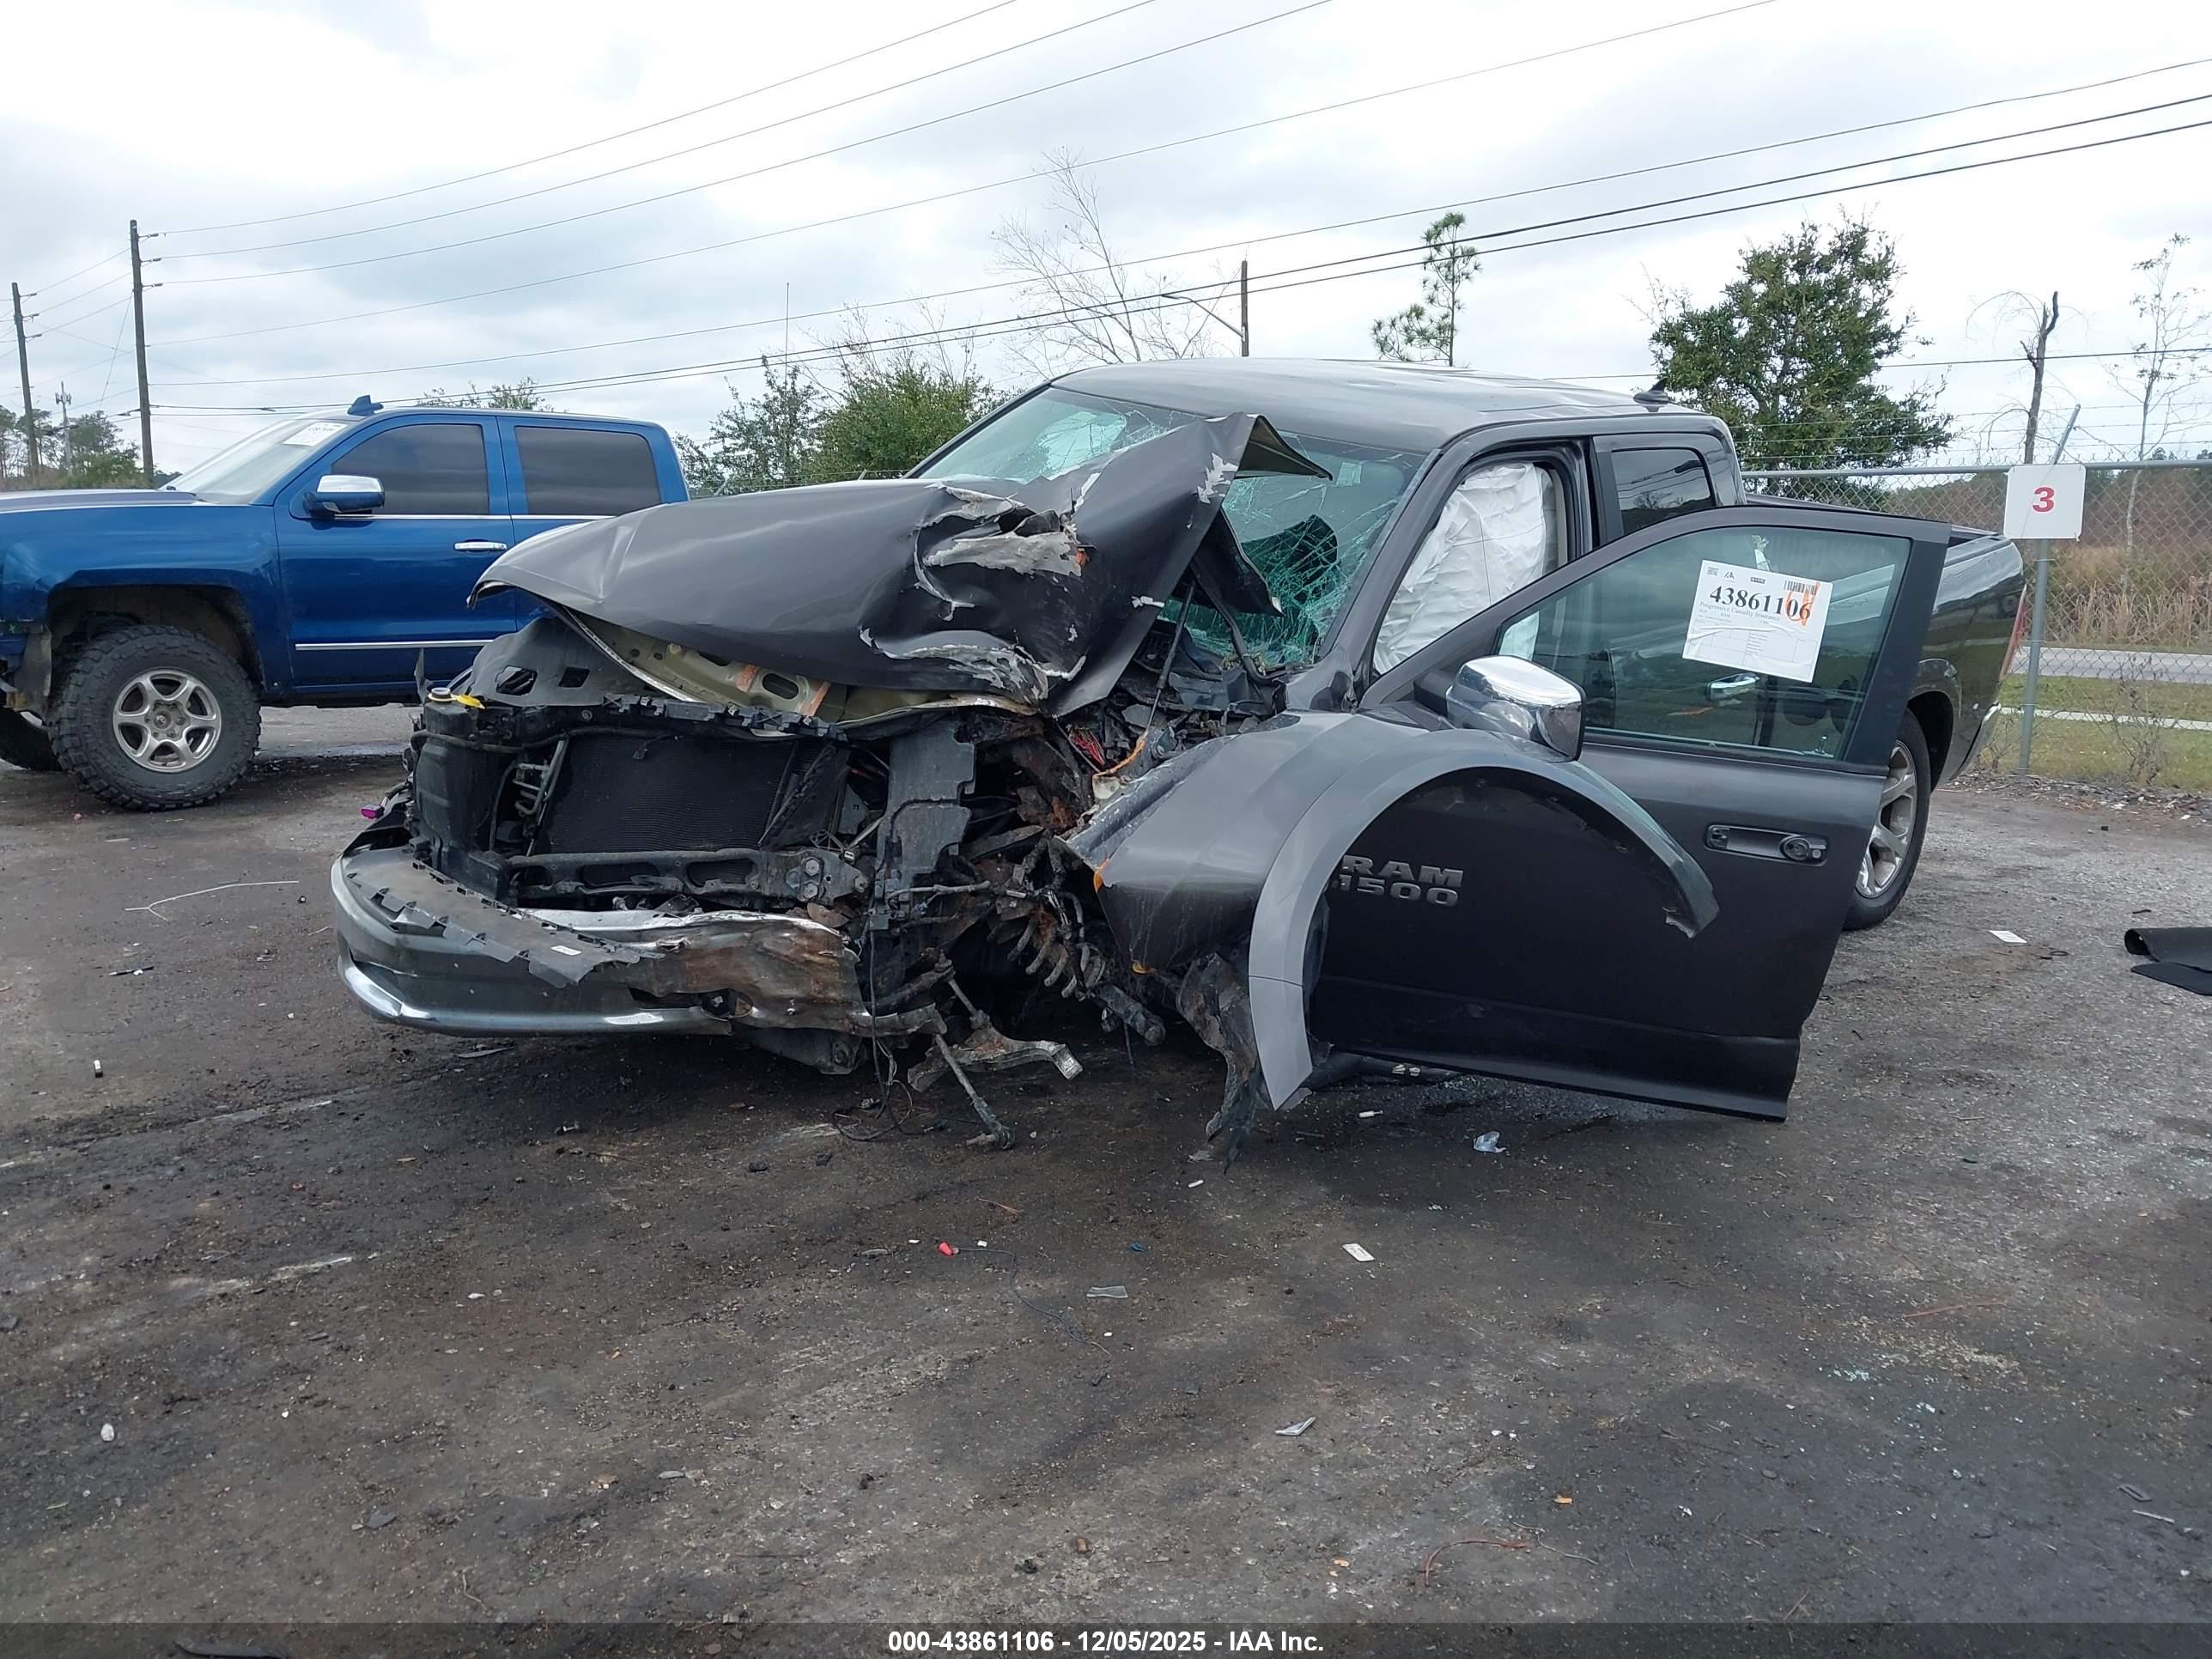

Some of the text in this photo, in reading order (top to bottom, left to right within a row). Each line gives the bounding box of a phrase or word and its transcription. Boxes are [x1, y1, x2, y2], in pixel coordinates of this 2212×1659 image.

[2032, 486, 2056, 513] 3
[1699, 601, 1730, 613] Progressive
[1731, 607, 1754, 617] Casualty
[1754, 611, 1780, 622] Insurance
[1710, 586, 1814, 619] 43861106
[1341, 854, 1464, 888] RAM
[1336, 873, 1459, 908] 1500
